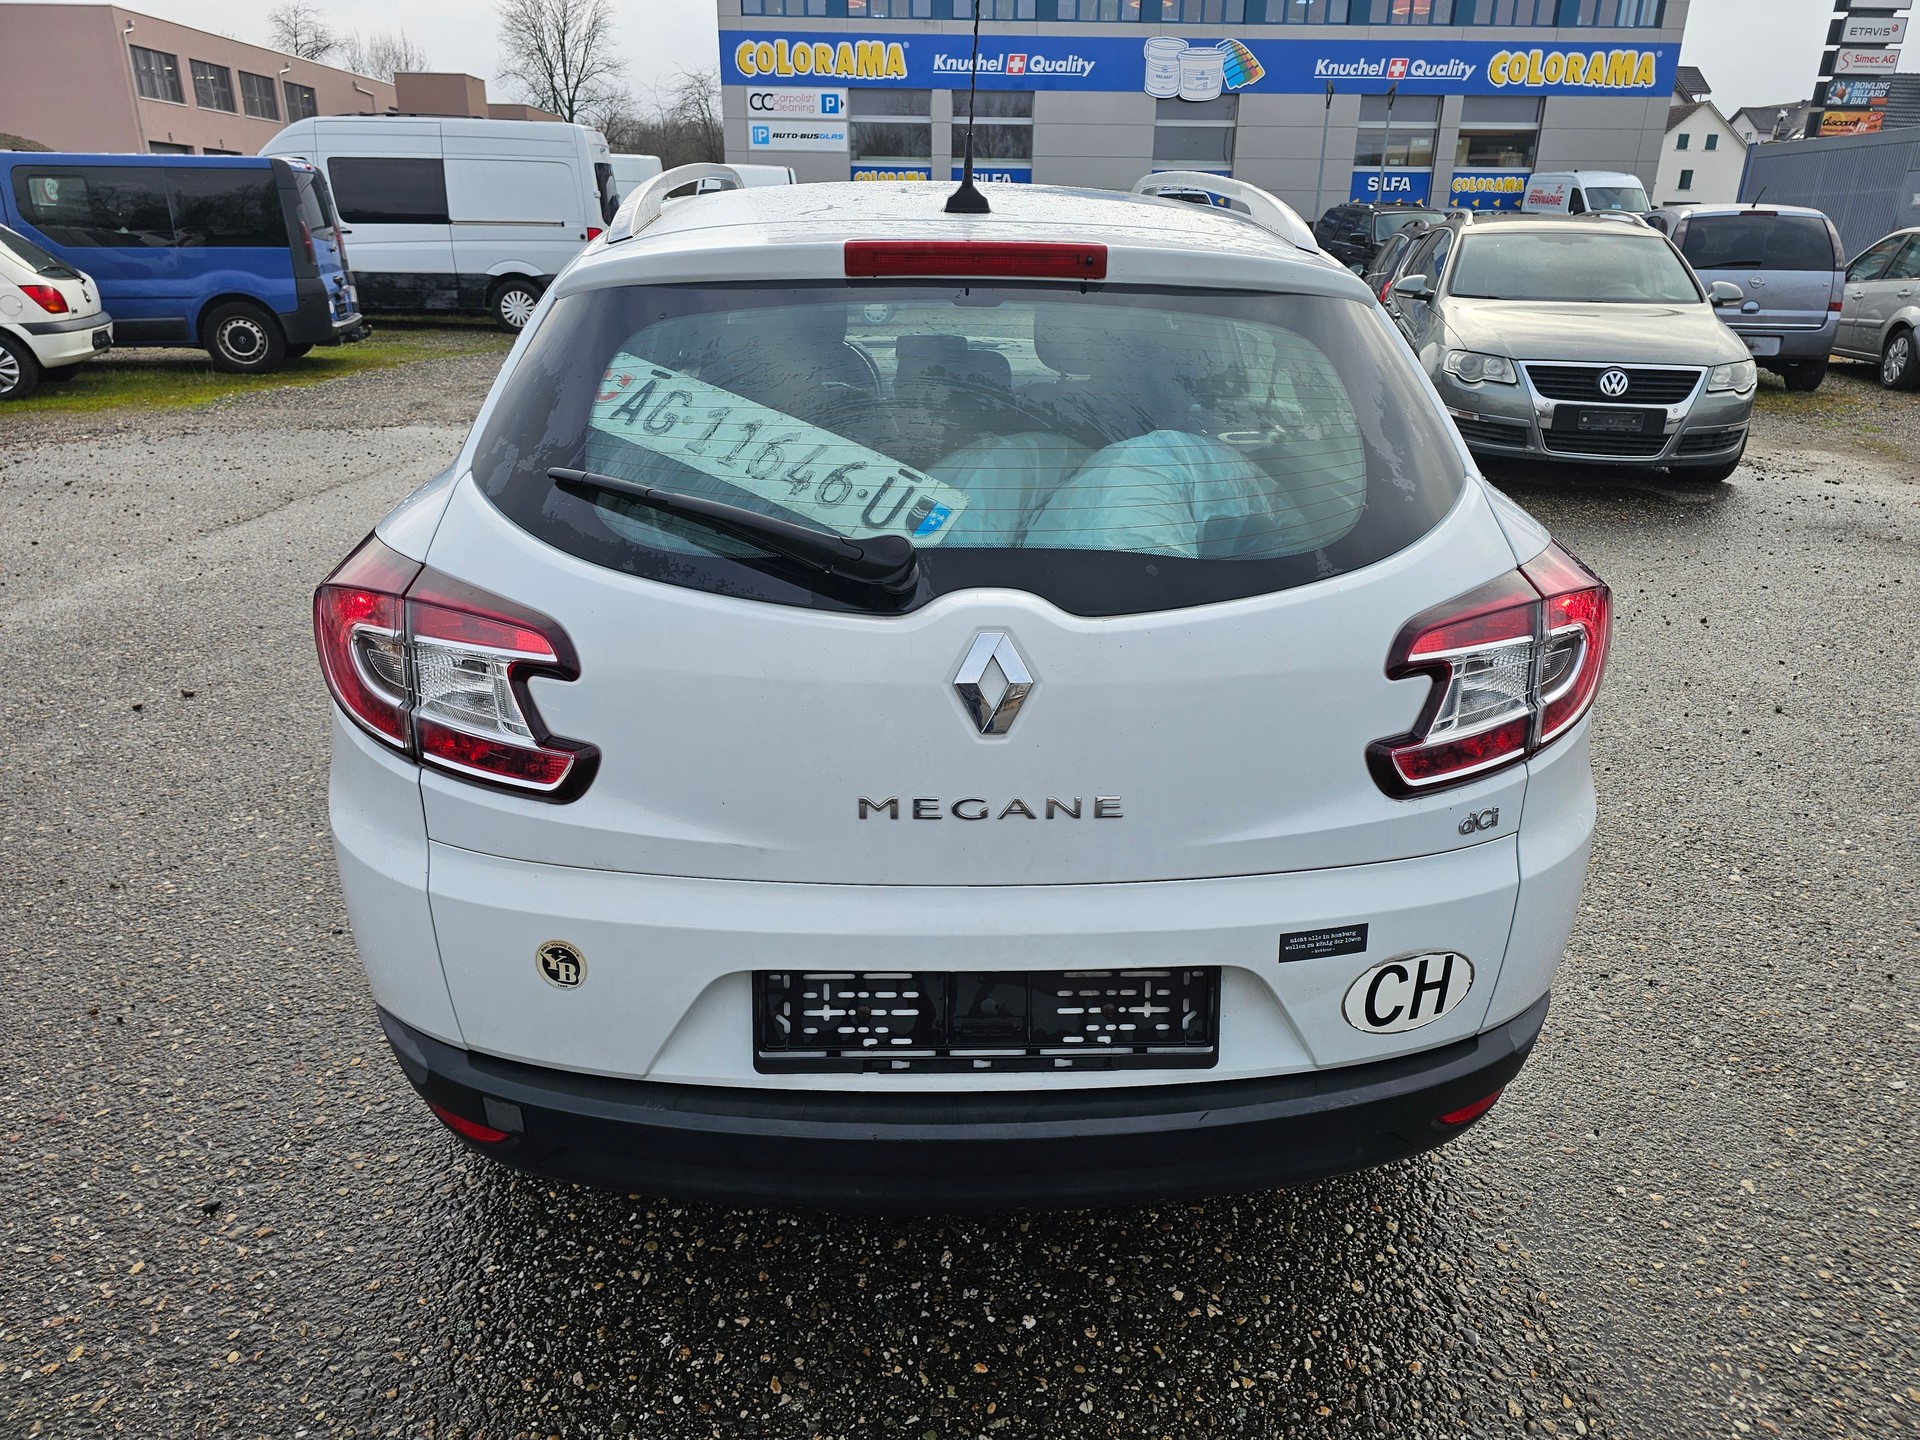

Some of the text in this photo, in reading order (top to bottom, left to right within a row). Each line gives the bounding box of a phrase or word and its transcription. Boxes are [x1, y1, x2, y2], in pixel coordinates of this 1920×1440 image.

[1850, 27, 1891, 36] ETAVIS
[1030, 55, 1096, 77] Quality
[1854, 54, 1896, 63] Simec AG
[1315, 58, 1476, 81] Knuchel Quality
[1854, 82, 1891, 90] BOWLING
[773, 103, 815, 114] Cleaning
[1367, 176, 1411, 192] SLFA
[858, 795, 1124, 820] MEGANE
[1365, 955, 1454, 1027] CH
